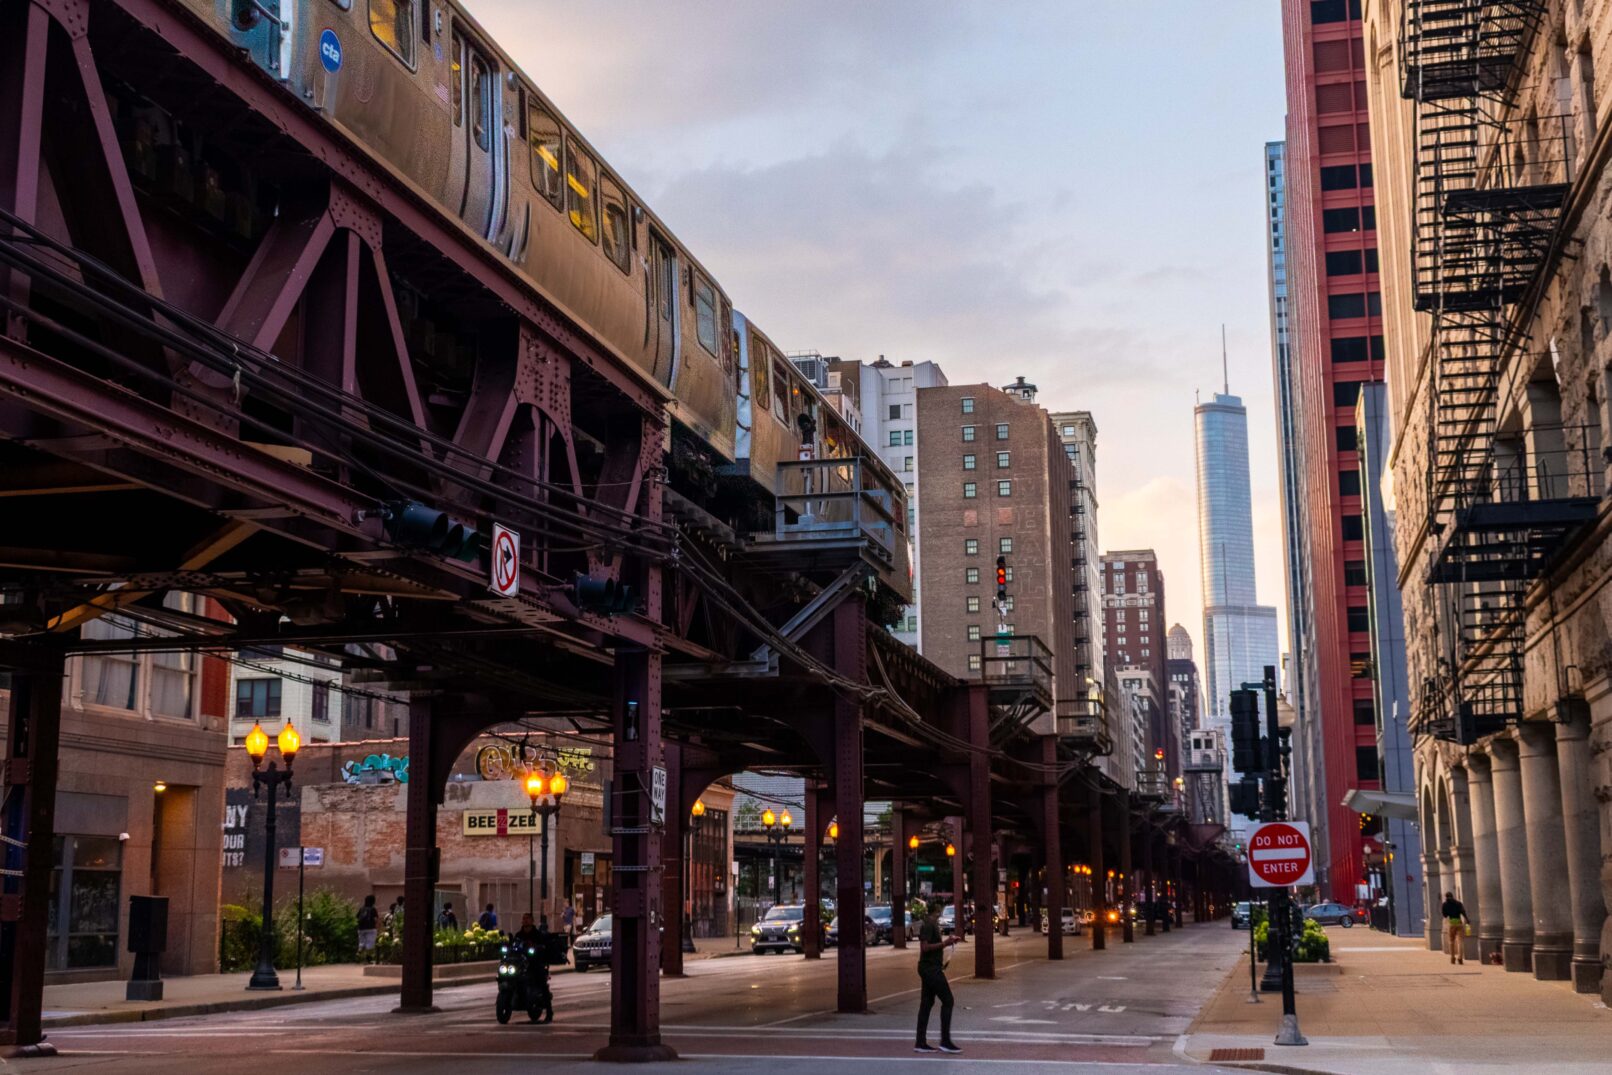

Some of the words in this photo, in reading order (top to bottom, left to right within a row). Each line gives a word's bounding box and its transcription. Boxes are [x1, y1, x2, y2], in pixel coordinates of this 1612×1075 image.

[322, 42, 340, 63] cta
[655, 771, 665, 786] ONE
[654, 786, 664, 800] WAY
[468, 816, 496, 828] BEE
[1256, 836, 1271, 846] DO
[1277, 834, 1299, 845] NOT
[1263, 862, 1298, 874] ENTER
